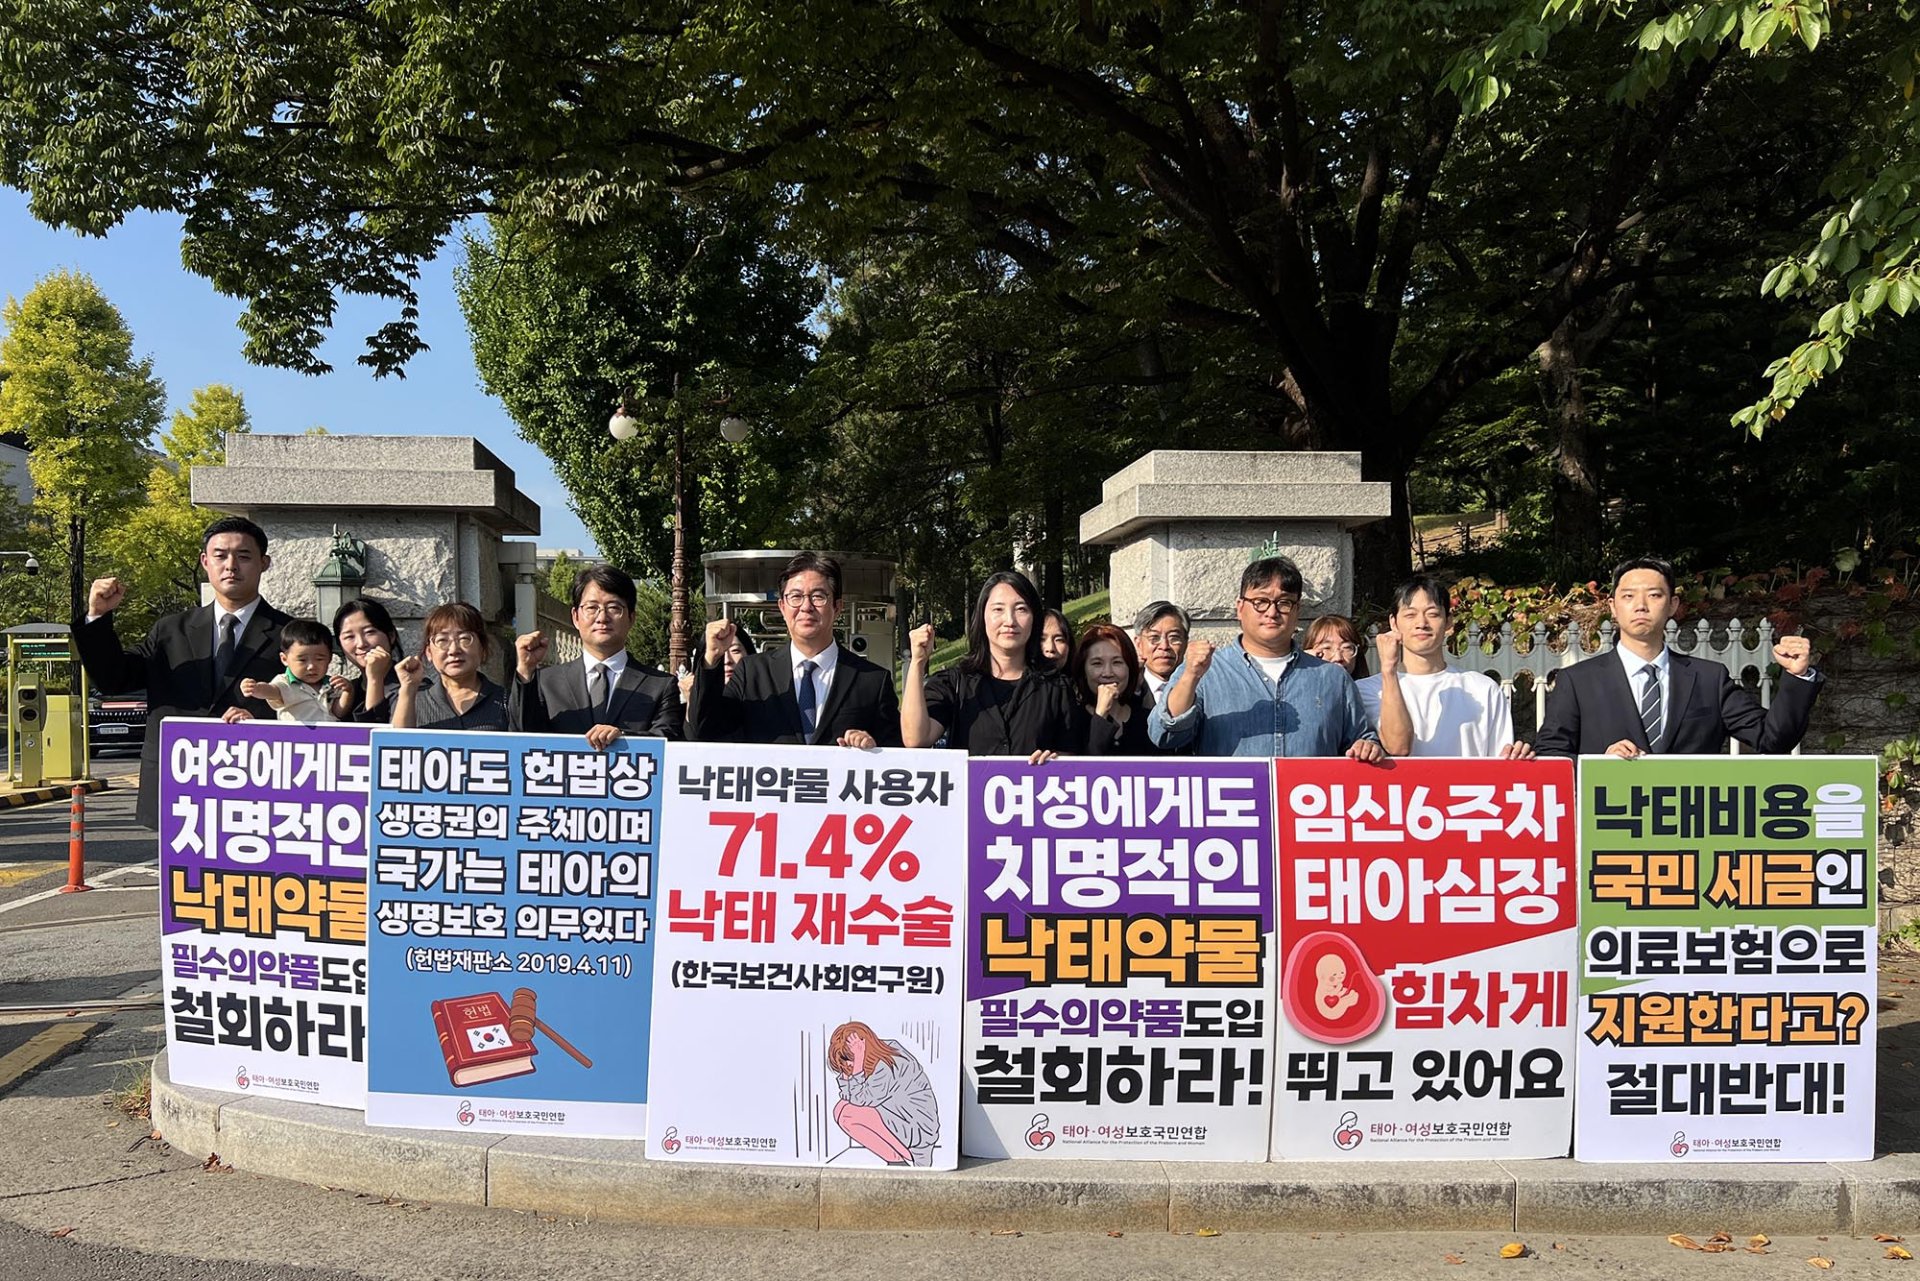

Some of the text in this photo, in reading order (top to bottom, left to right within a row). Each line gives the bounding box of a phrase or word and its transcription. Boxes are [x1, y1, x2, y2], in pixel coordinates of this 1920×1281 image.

[171, 738, 370, 792] 여성에게도
[378, 748, 656, 799] 태아도 헌법상
[678, 766, 954, 806] 낙태약물 사용자
[378, 803, 651, 843] 생명권의 주체이며
[984, 776, 1260, 828] 여성에게도
[1289, 783, 1566, 842] 임신6주차
[1594, 784, 1865, 839] 낙태비용을
[170, 796, 369, 868] 치명적인
[709, 811, 920, 882] 71.4%
[376, 846, 652, 898] 국가는 태아의
[984, 836, 1260, 908] 치명적인
[1294, 858, 1566, 924] 태아심장
[1591, 851, 1866, 908] 국민 세금인
[171, 868, 366, 943] 낙태약물
[375, 902, 648, 943] 생명보호 의무있다
[668, 890, 954, 948] 낙태 재수술
[406, 947, 632, 978] (헌법재판소 2019.4.11)
[983, 915, 1264, 985] 낙태약물
[1590, 930, 1866, 975] 의료보험으로
[671, 960, 944, 995] (한국보건사회연구원)
[1392, 970, 1568, 1029] 힘차게
[463, 1004, 492, 1019] 헌법
[980, 999, 1264, 1038] 필수의약품도입
[1587, 992, 1868, 1045] 지원한다고?
[974, 1045, 1264, 1106] 철회하라!
[1286, 1048, 1565, 1102] 뛰고 있어요
[1606, 1062, 1845, 1115] 절대반대!
